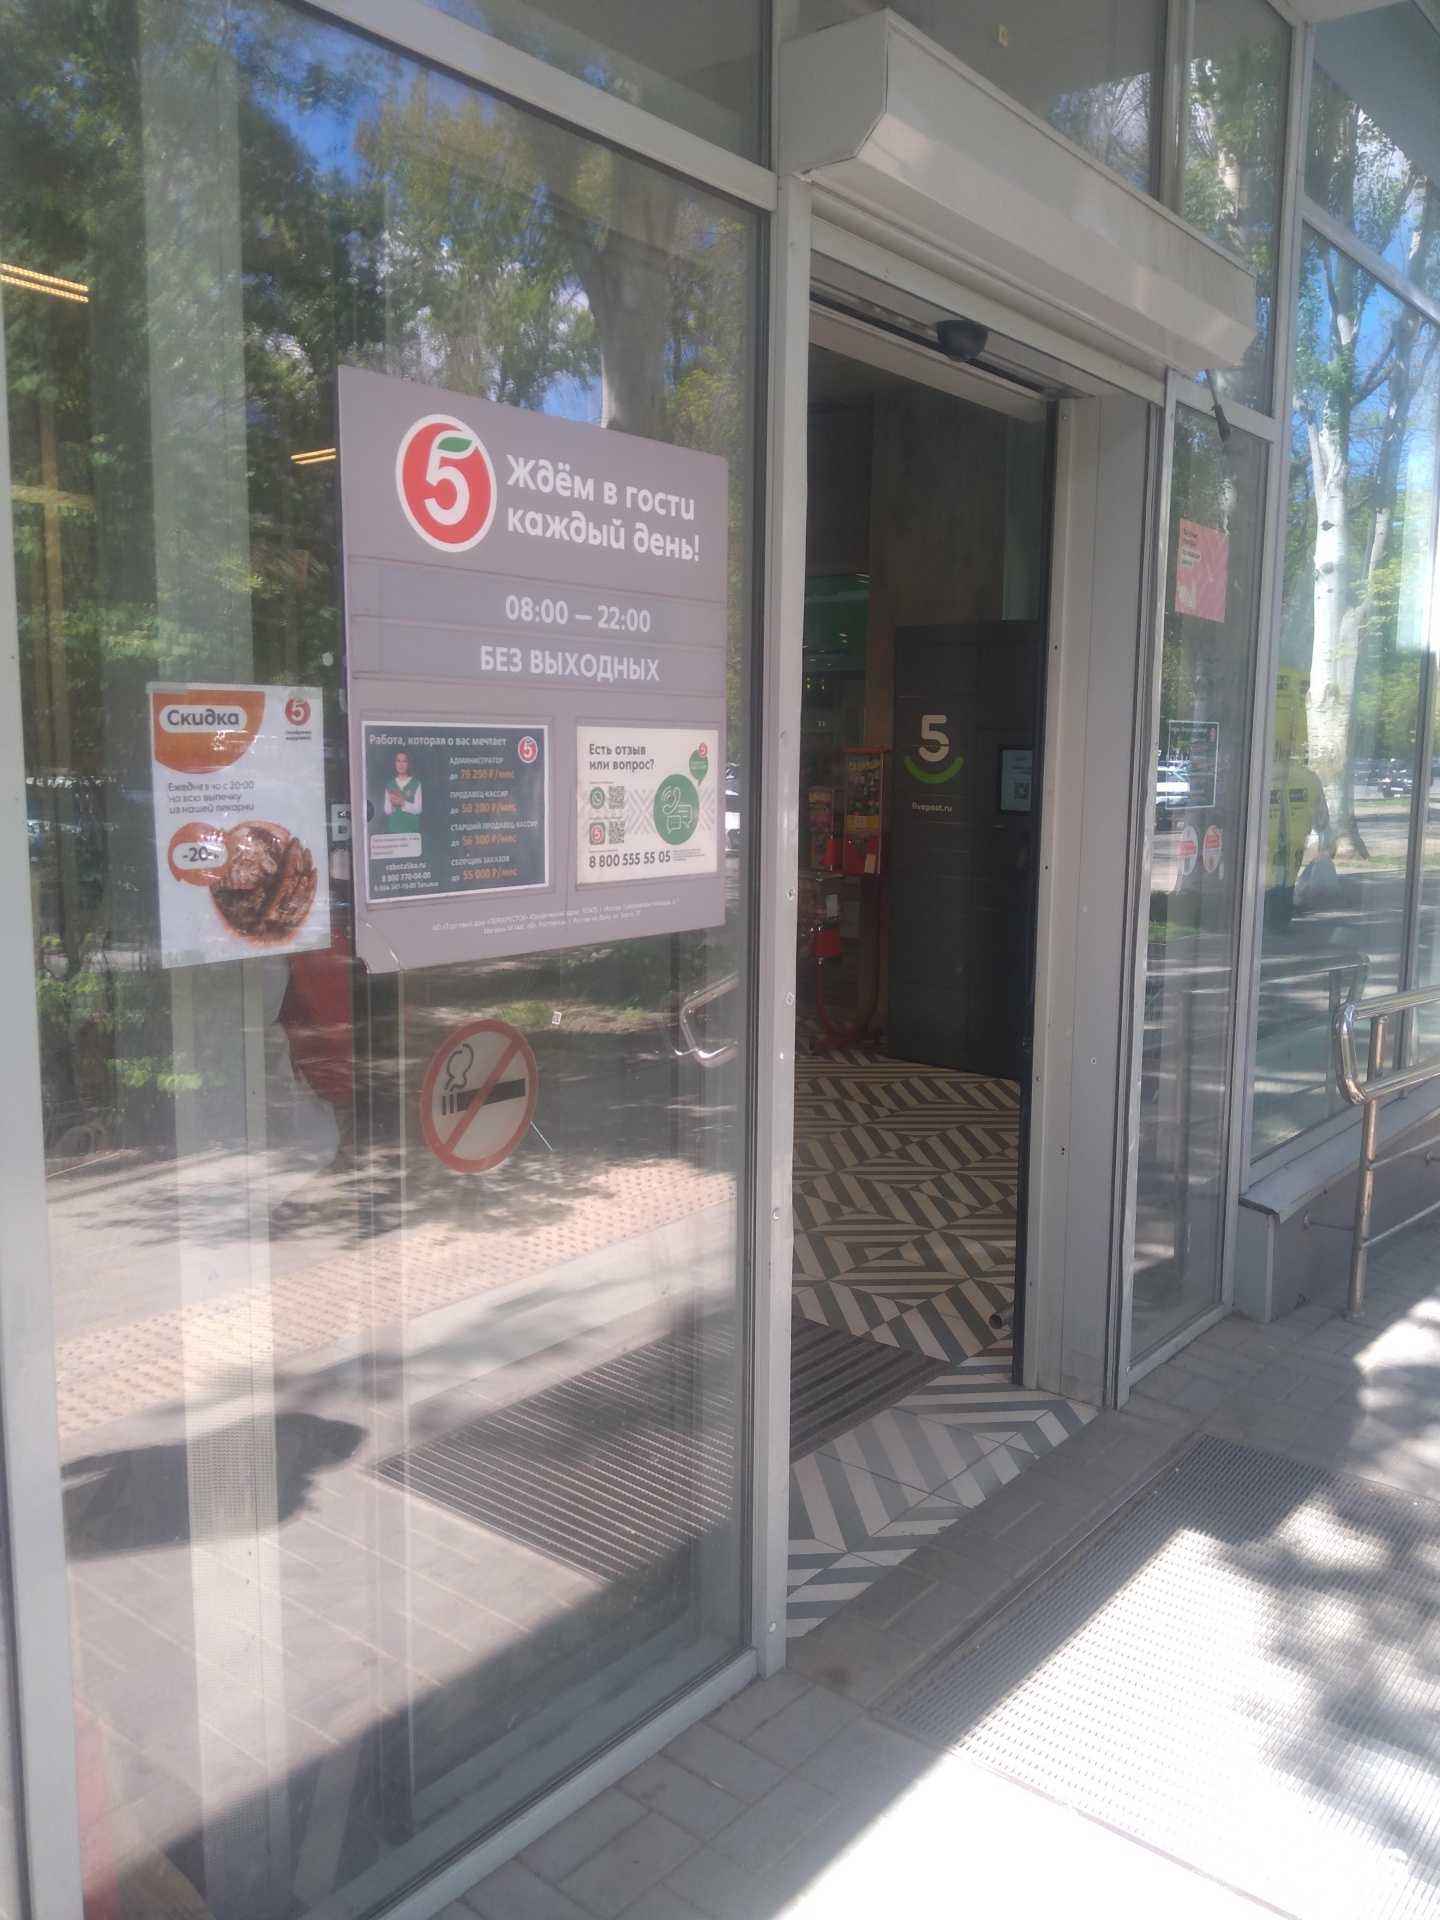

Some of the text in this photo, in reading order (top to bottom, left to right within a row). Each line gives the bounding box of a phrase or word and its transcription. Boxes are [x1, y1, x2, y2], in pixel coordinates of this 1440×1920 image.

[506, 453, 695, 522] Ждём в гости
[506, 507, 700, 562] каждый день!
[505, 595, 569, 625] 08:00
[597, 605, 651, 633] 22:00
[480, 645, 660, 682] БЕЗ ВЫХОДНЫХ
[166, 709, 240, 727] Скидка
[369, 734, 507, 747] Работа, которая о вас мечтает
[589, 744, 646, 756] Есть отзыв
[918, 714, 950, 762] 5
[589, 759, 655, 772] или вопрос?
[589, 855, 596, 869] 8
[599, 854, 620, 868] 800
[622, 852, 641, 866] 555
[644, 851, 656, 864] 55
[658, 850, 671, 863] 05
